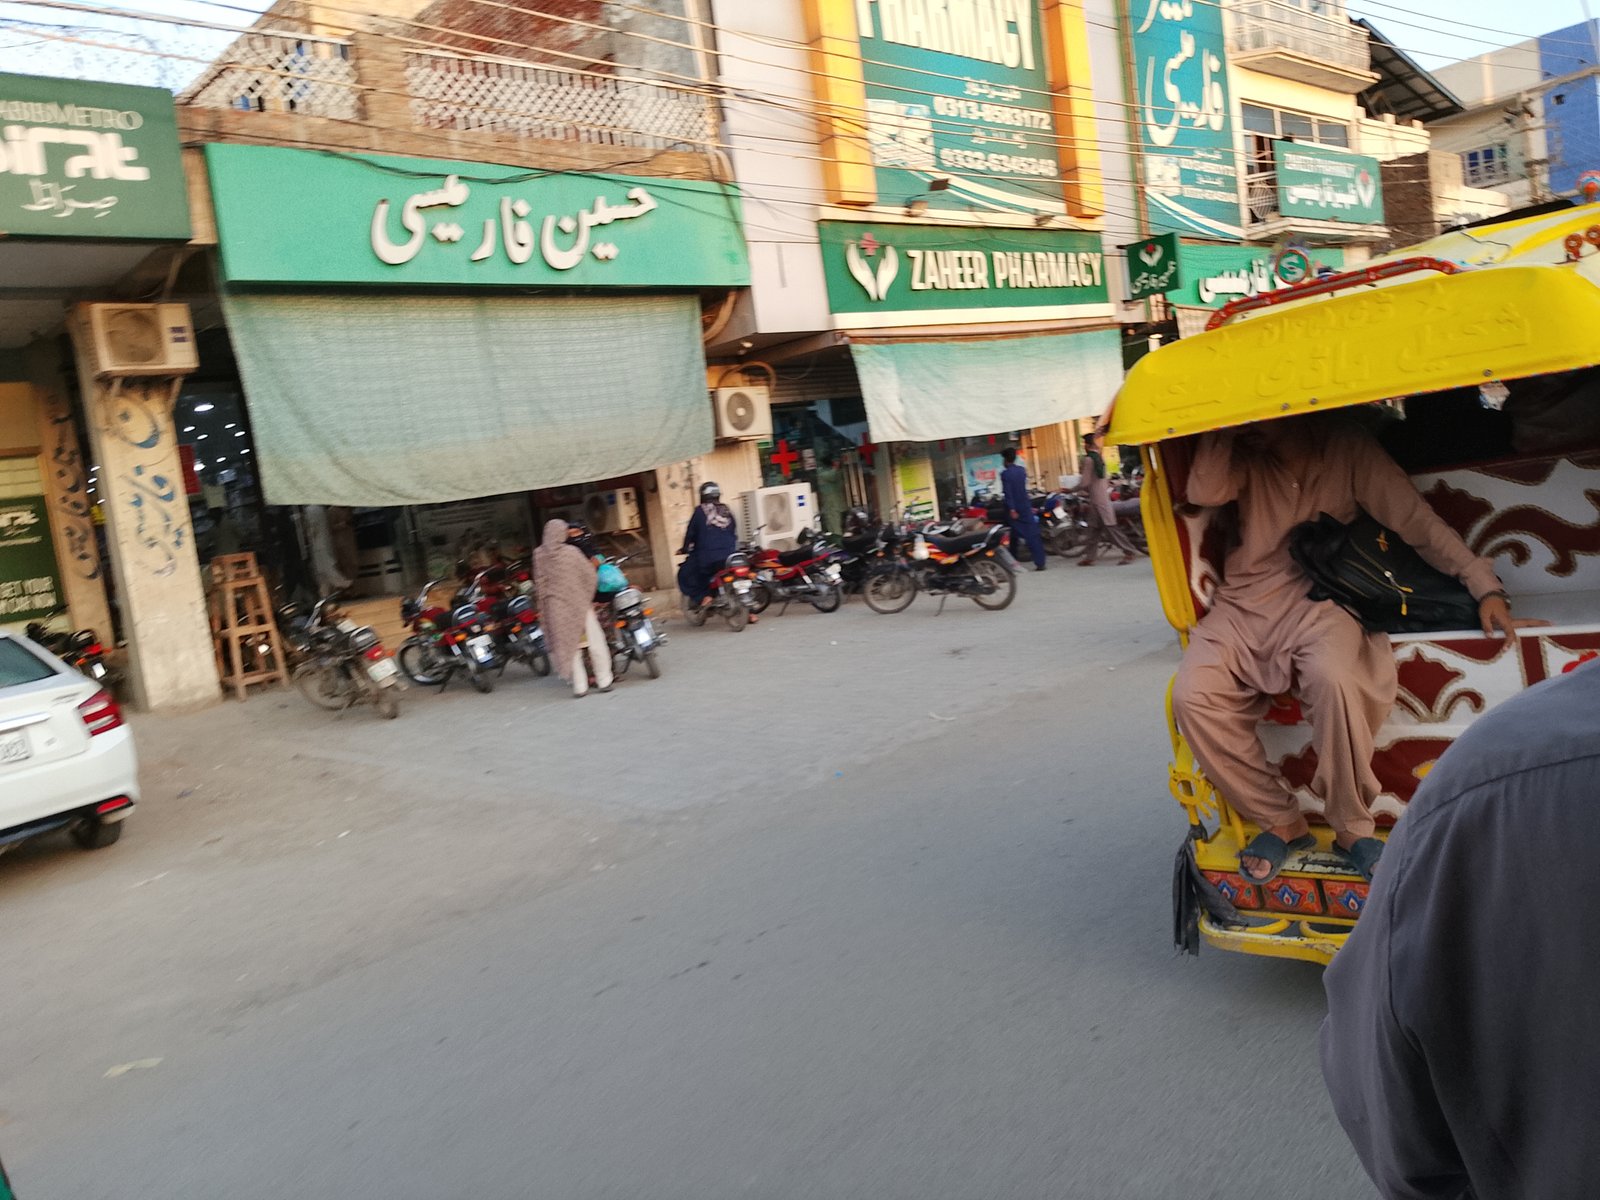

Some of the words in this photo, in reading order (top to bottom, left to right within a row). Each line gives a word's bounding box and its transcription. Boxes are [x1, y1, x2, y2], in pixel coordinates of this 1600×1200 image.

[0, 124, 151, 181] irat
[906, 249, 990, 291] ZAHEER
[991, 251, 1102, 289] PHARMACY
